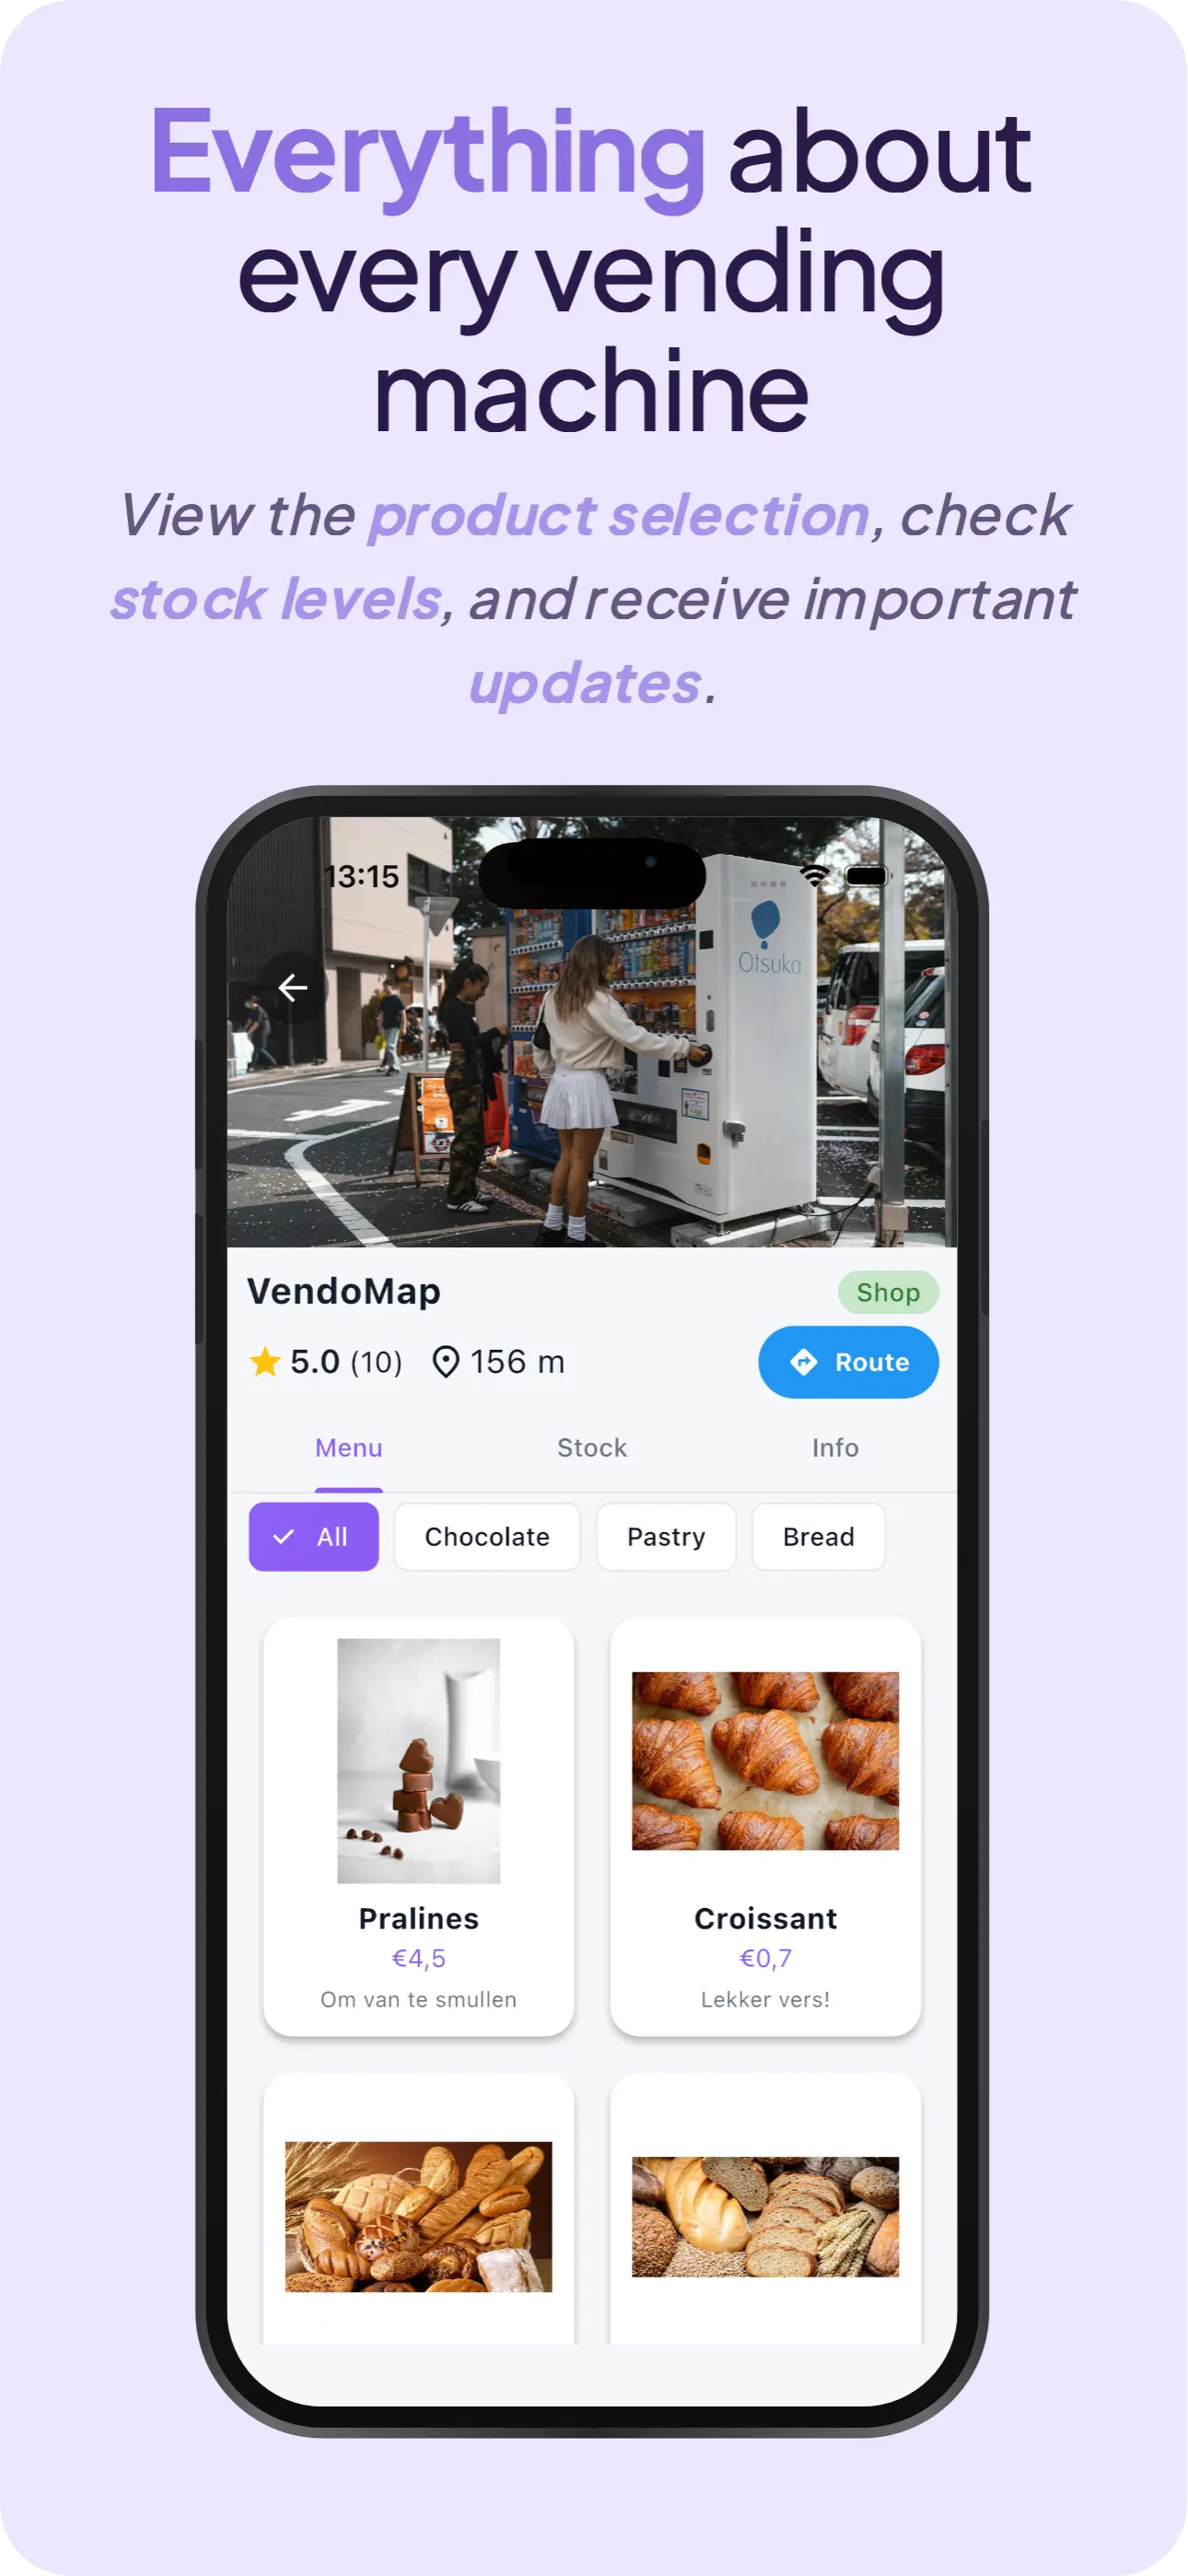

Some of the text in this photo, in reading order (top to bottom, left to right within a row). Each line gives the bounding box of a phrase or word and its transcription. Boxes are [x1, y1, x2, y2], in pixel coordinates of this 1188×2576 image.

[324, 864, 399, 888] 13:15
[739, 951, 802, 975] Otsuka
[247, 1276, 440, 1310] VendoMap
[858, 1282, 920, 1306] Shop
[291, 1349, 402, 1377] 5.0 (10)
[472, 1349, 564, 1374] 156 m
[836, 1352, 910, 1372] Route
[317, 1438, 381, 1457] Menu
[558, 1437, 627, 1457] Stock
[814, 1437, 858, 1457] Info
[317, 1526, 346, 1546] All
[425, 1527, 550, 1546] Chocolate
[629, 1528, 705, 1551] Pastry
[785, 1527, 854, 1546] Bread
[360, 1906, 479, 1929] Pralines
[695, 1906, 837, 1929] Croissant
[392, 1949, 445, 1972] €4,5
[740, 1949, 791, 1972] €0,7
[321, 1991, 516, 2008] Om van te smullen
[703, 1991, 829, 2008] Lekker vers!
